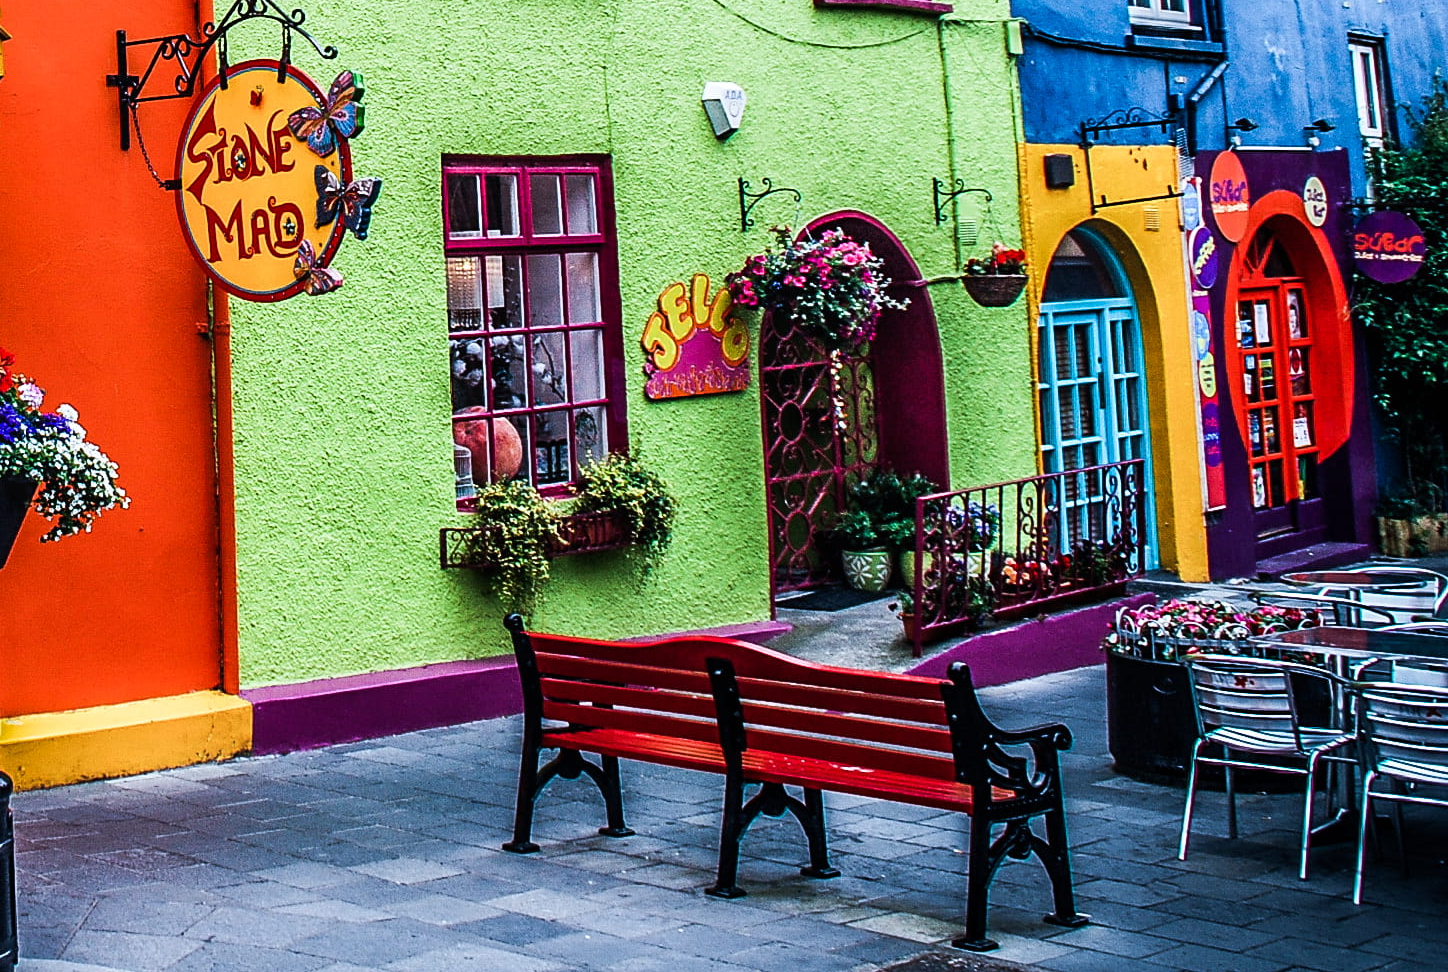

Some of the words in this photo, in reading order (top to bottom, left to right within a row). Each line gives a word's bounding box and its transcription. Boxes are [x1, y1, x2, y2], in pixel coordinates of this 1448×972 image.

[187, 95, 296, 205] STONE
[202, 196, 304, 263] MAD
[642, 274, 750, 371] JELLO
